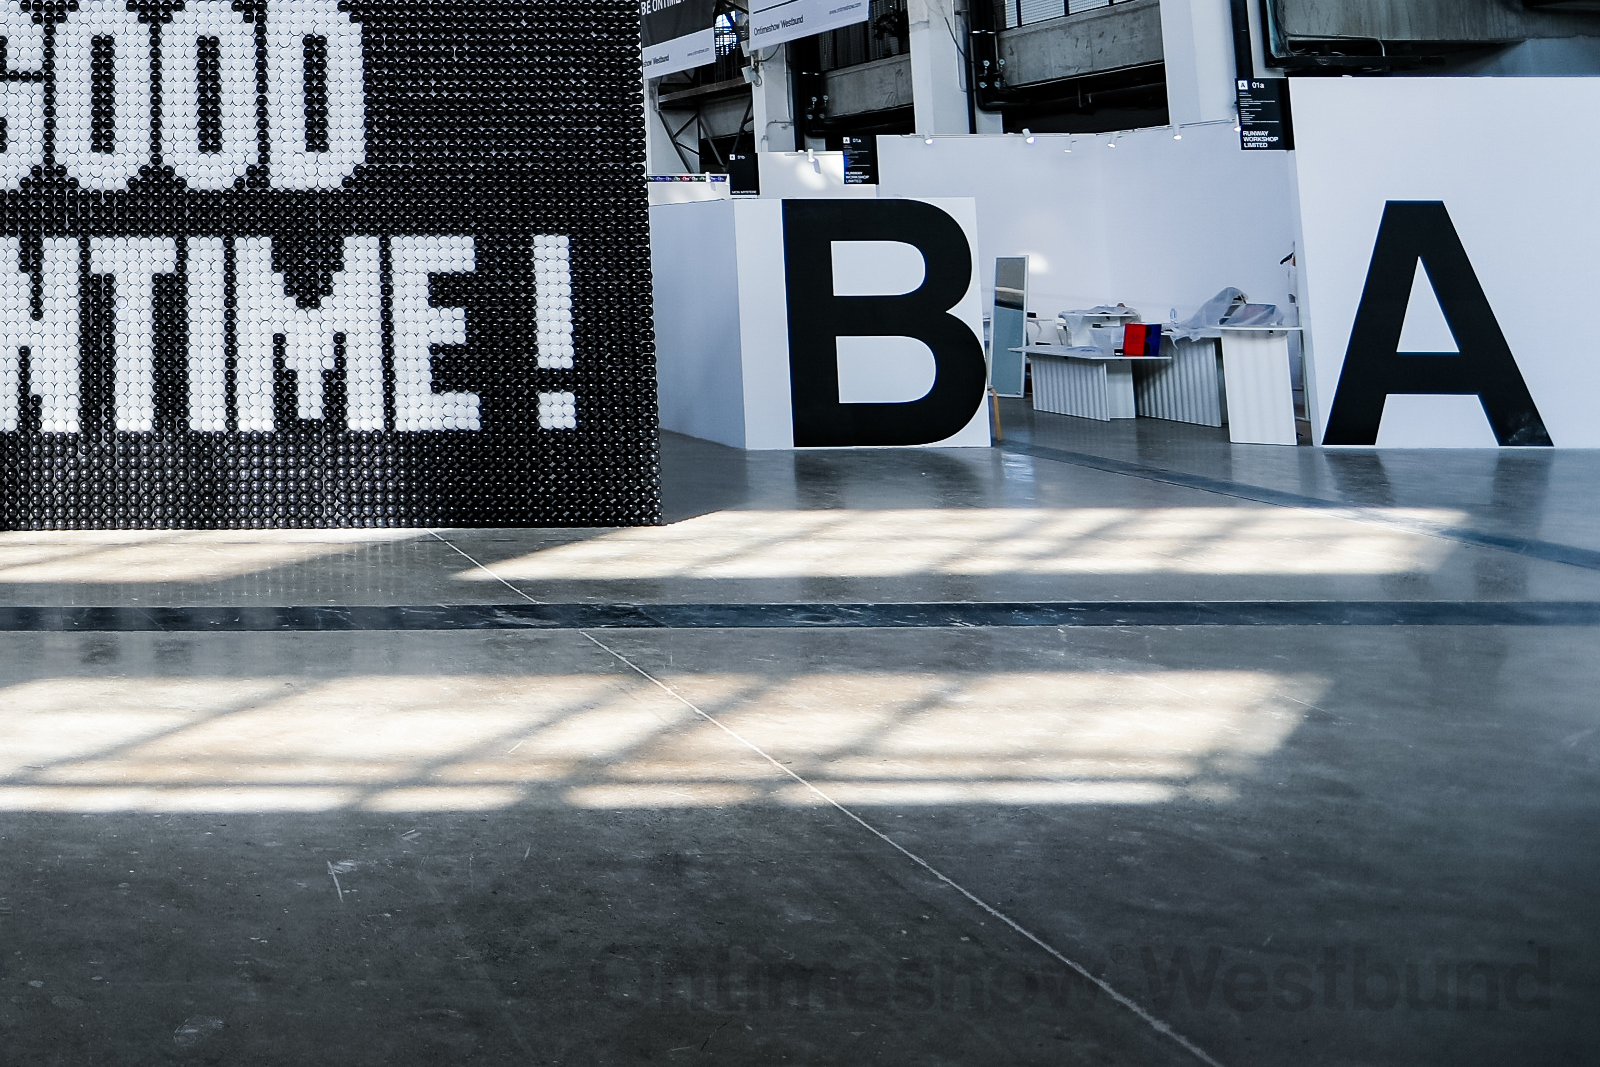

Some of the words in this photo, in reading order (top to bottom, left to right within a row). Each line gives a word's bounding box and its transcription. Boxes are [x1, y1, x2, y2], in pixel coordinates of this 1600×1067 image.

[641, 0, 652, 16] BE
[753, 23, 780, 36] Ontimeshow
[780, 15, 804, 29] Westbund
[532, 234, 577, 430] !
[782, 198, 988, 448] B
[1322, 200, 1554, 447] A
